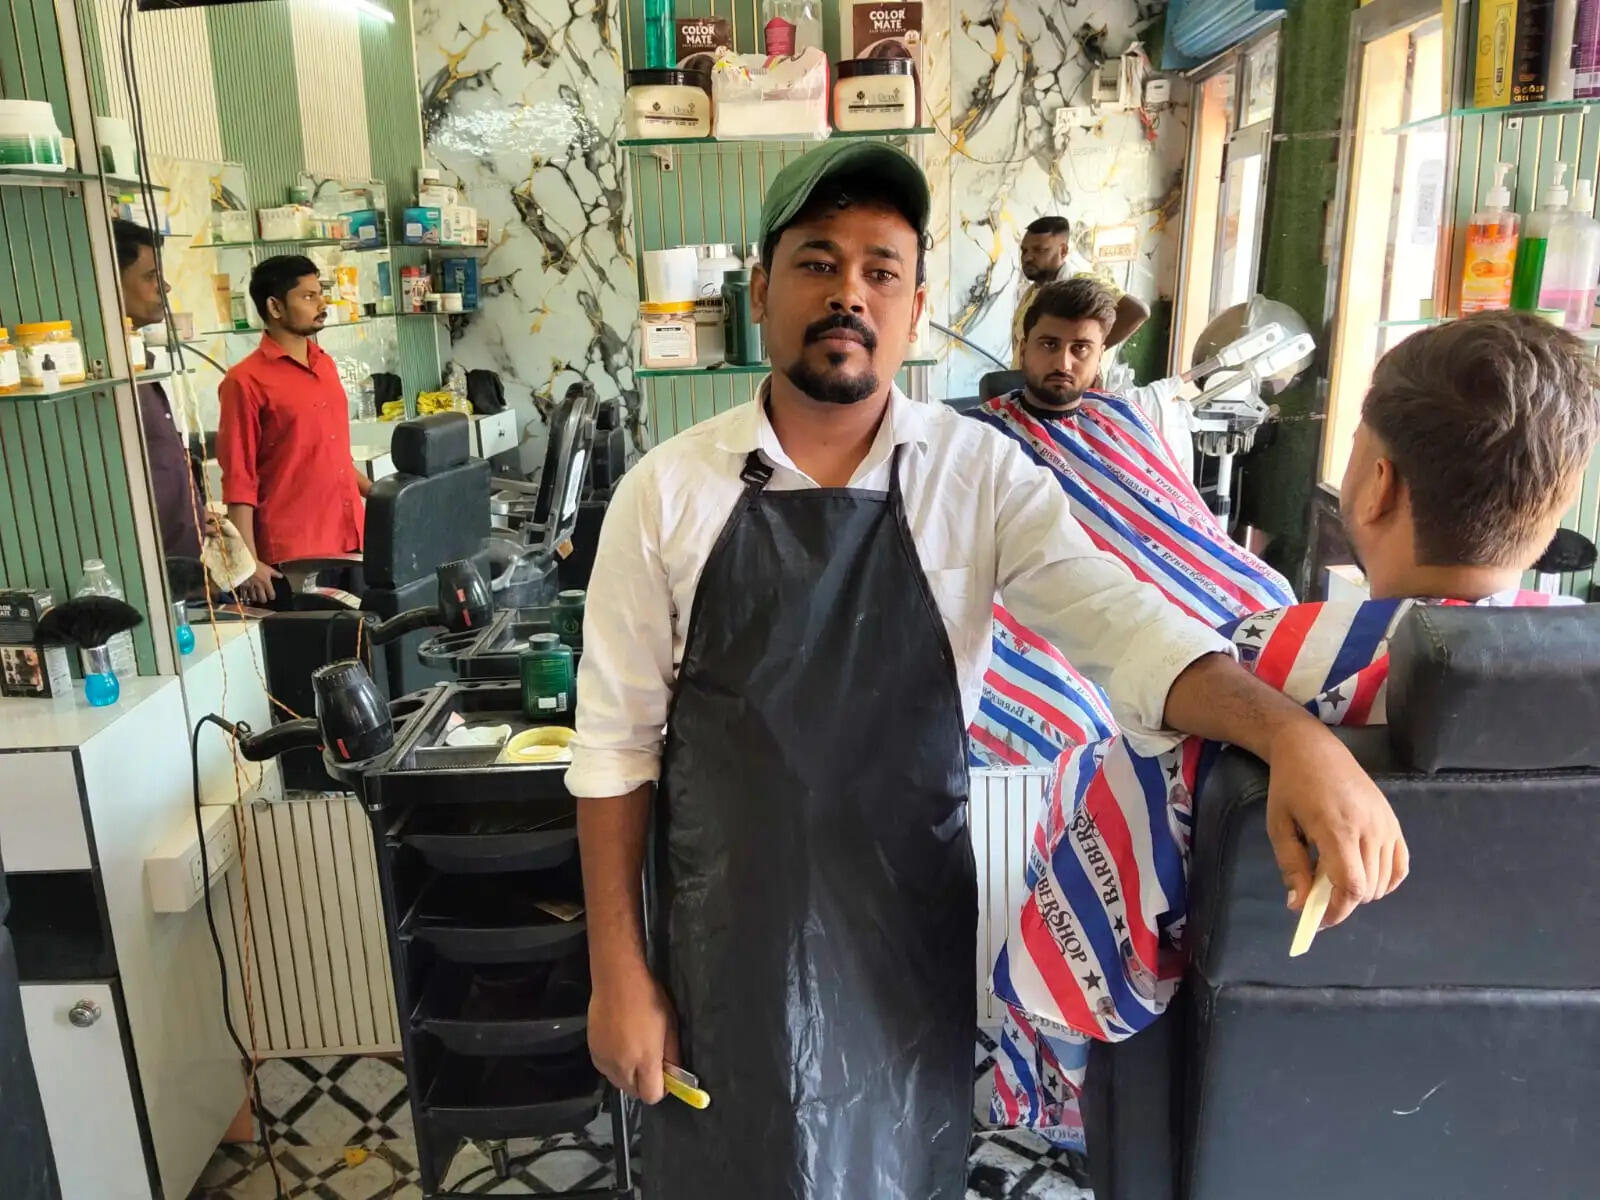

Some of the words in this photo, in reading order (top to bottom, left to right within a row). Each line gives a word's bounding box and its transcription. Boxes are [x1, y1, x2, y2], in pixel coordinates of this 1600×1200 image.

[869, 9, 906, 20] COLOR
[681, 24, 716, 35] COLOR
[873, 19, 903, 30] MATE
[686, 34, 713, 44] MATE
